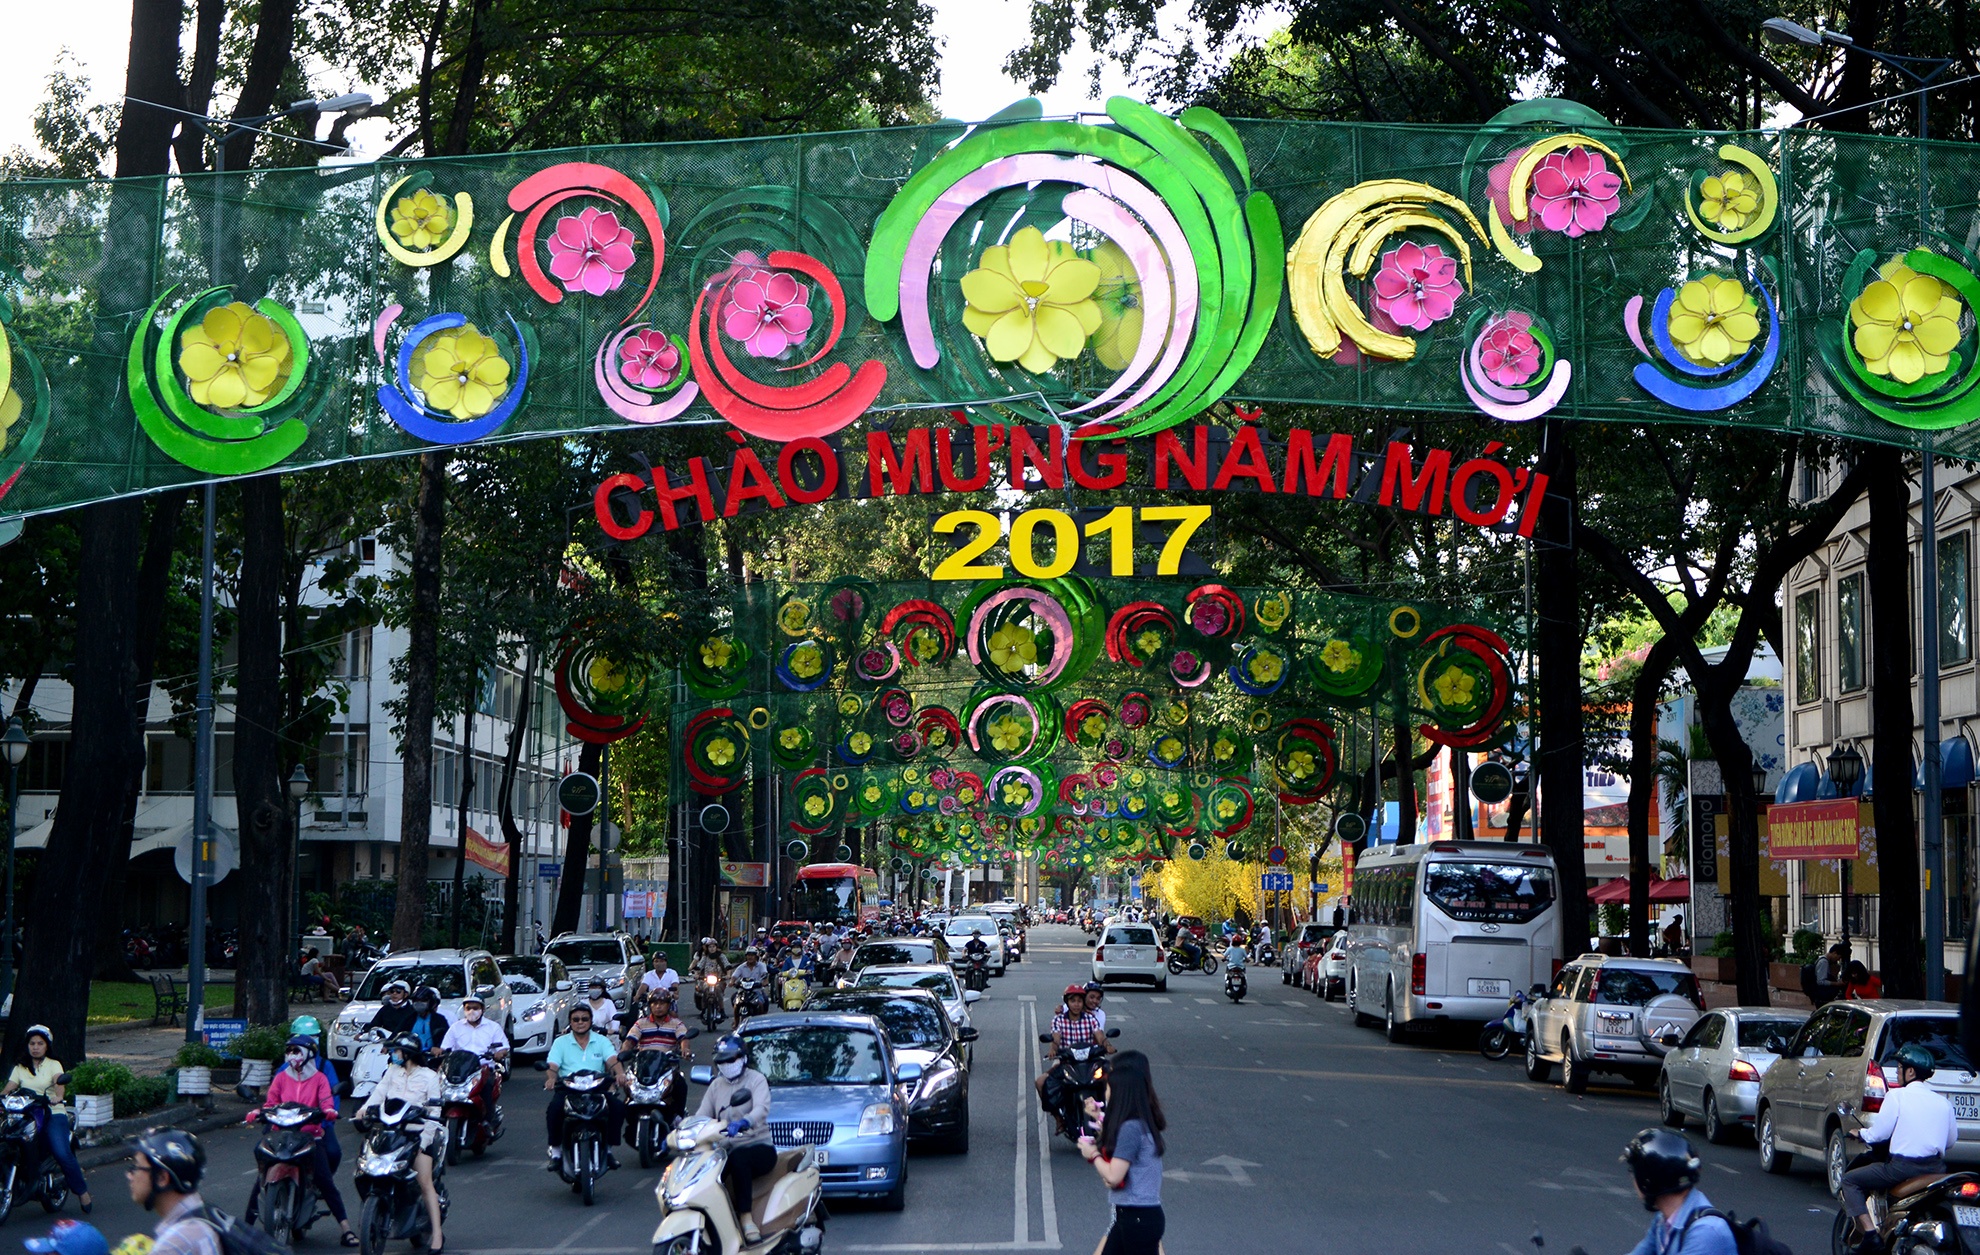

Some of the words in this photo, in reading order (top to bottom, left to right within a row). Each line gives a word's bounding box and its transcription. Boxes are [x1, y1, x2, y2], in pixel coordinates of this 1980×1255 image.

[594, 430, 838, 540] CHÀO
[866, 410, 1127, 497] MỪNG
[1155, 406, 1353, 499] NĂM
[1378, 441, 1549, 538] MỚI
[931, 505, 1212, 580] 2017
[1698, 800, 1714, 876] diamond
[1955, 1095, 1975, 1106] 50LD
